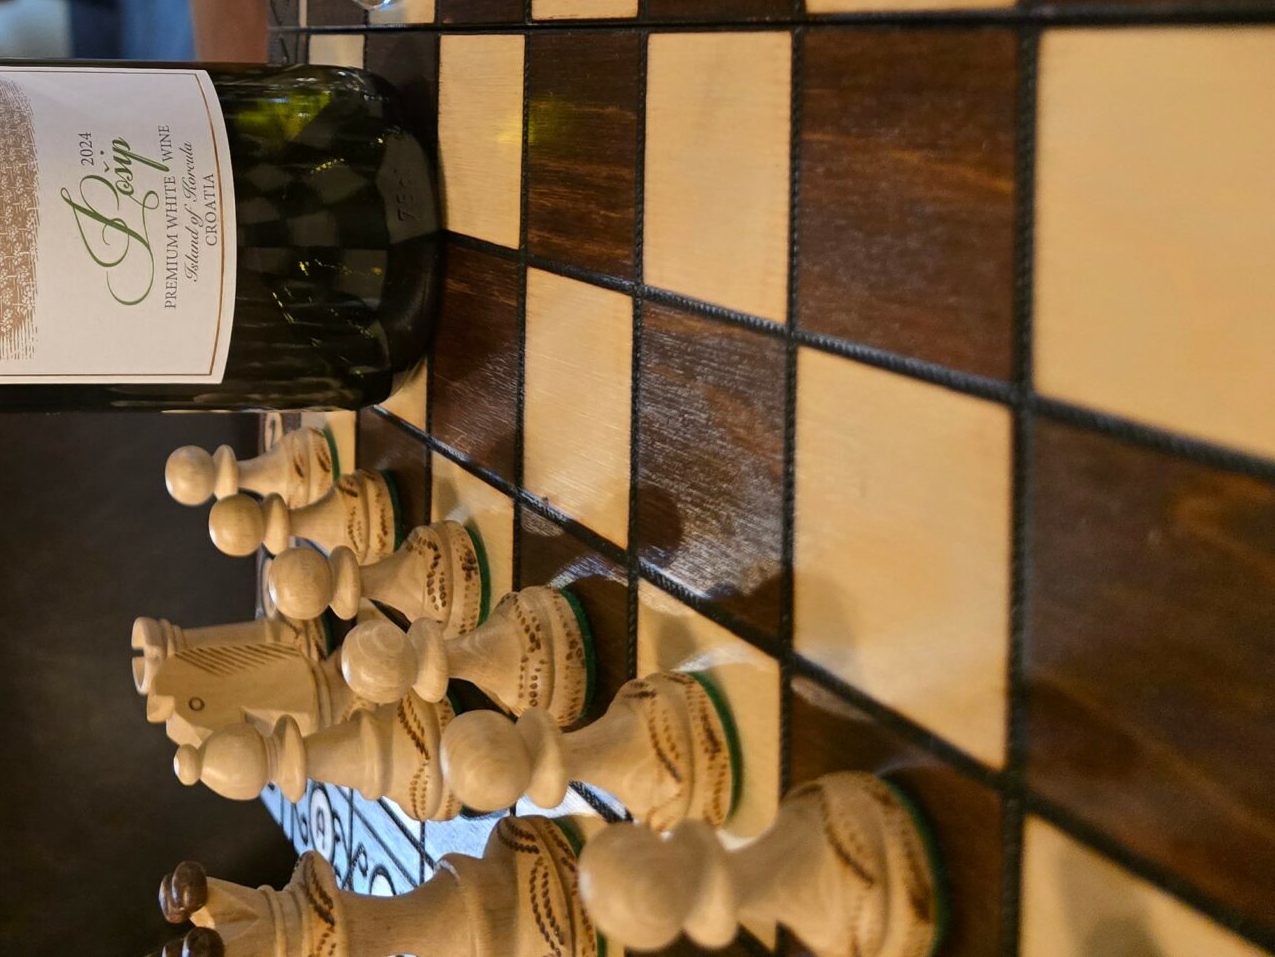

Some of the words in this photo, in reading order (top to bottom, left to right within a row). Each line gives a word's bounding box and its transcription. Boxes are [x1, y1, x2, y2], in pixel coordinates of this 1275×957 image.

[79, 132, 94, 166] 2024
[157, 124, 173, 162] WINE
[179, 141, 197, 202] Korcula
[60, 136, 169, 306] Pošip
[163, 176, 178, 230] WHITE
[183, 204, 203, 228] of
[203, 174, 217, 246] CROATIA
[164, 234, 179, 308] PREMIUM
[183, 226, 199, 282] Island
